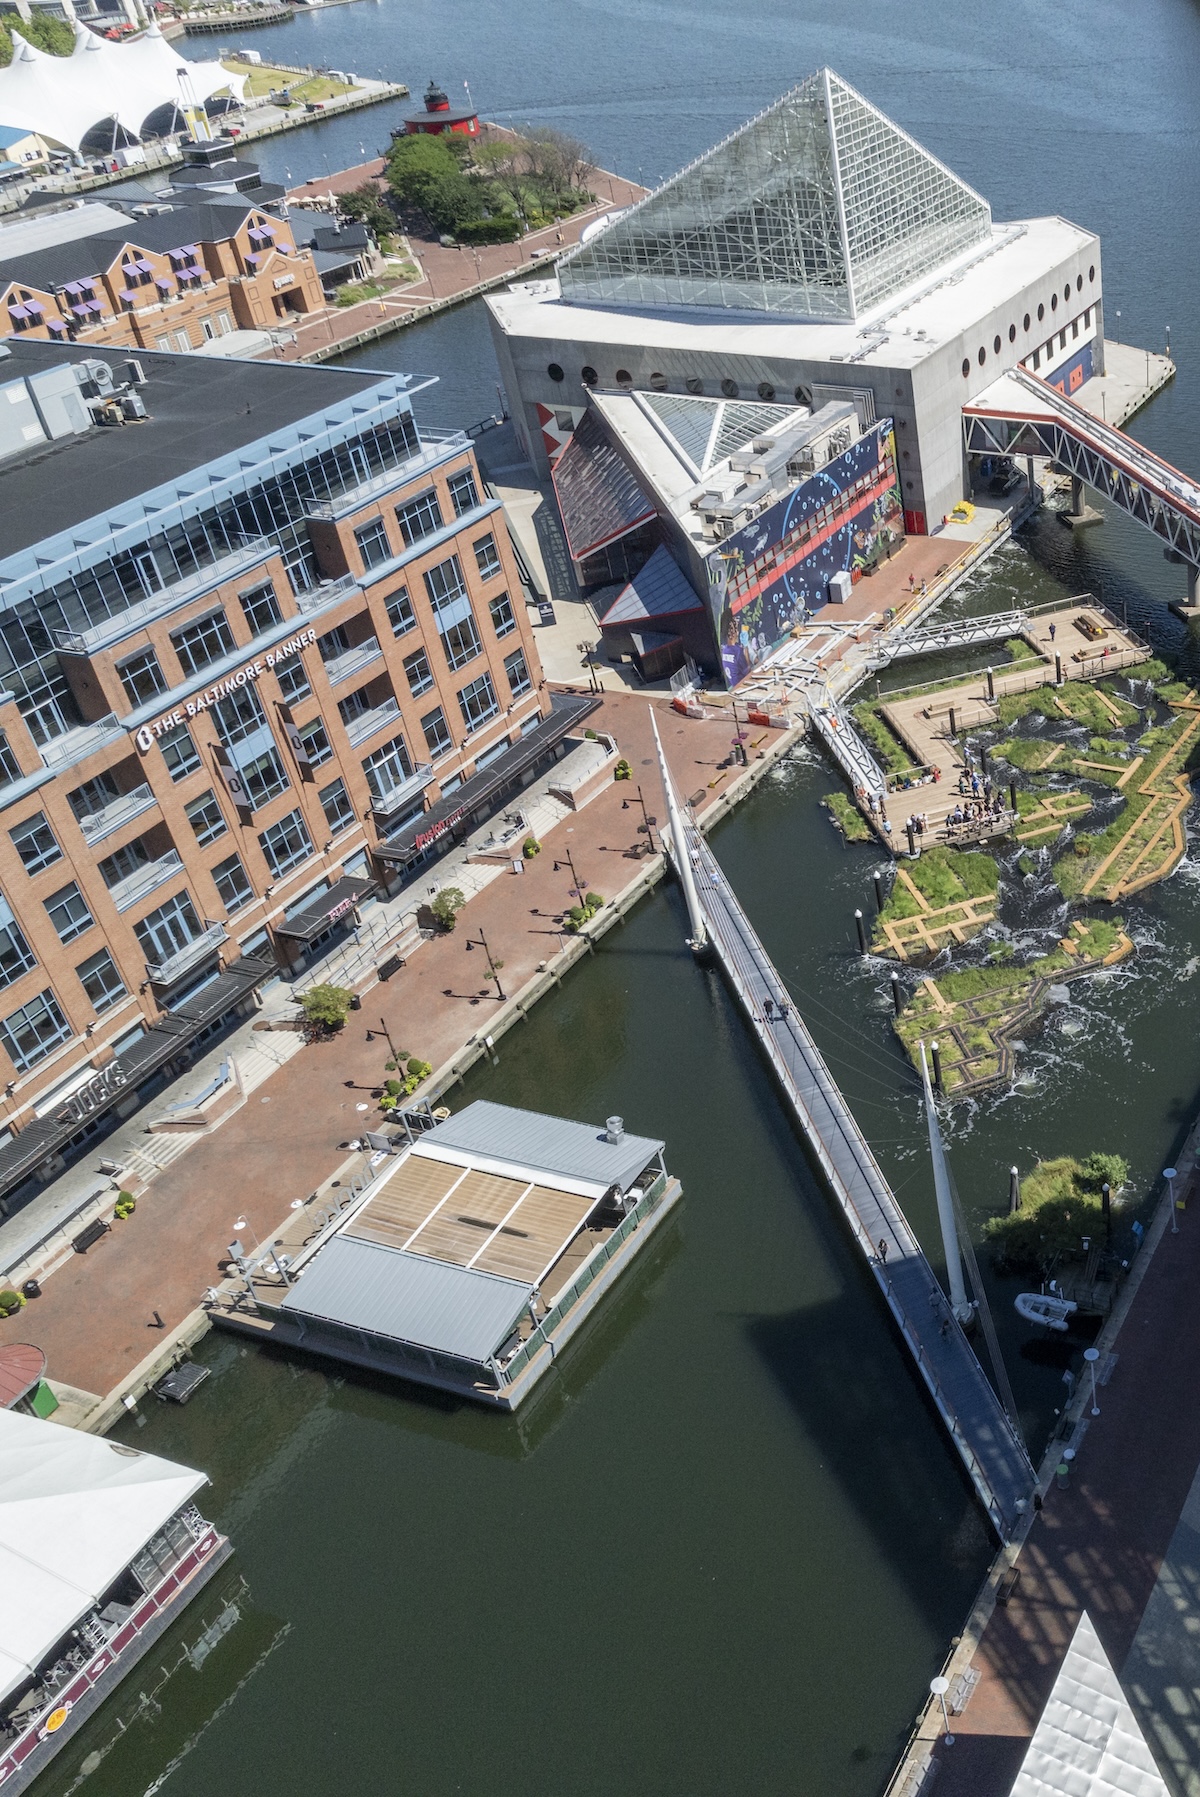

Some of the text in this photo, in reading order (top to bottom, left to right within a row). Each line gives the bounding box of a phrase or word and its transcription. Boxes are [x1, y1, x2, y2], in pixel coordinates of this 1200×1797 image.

[153, 628, 317, 735] THE BALTIMORE BANNER
